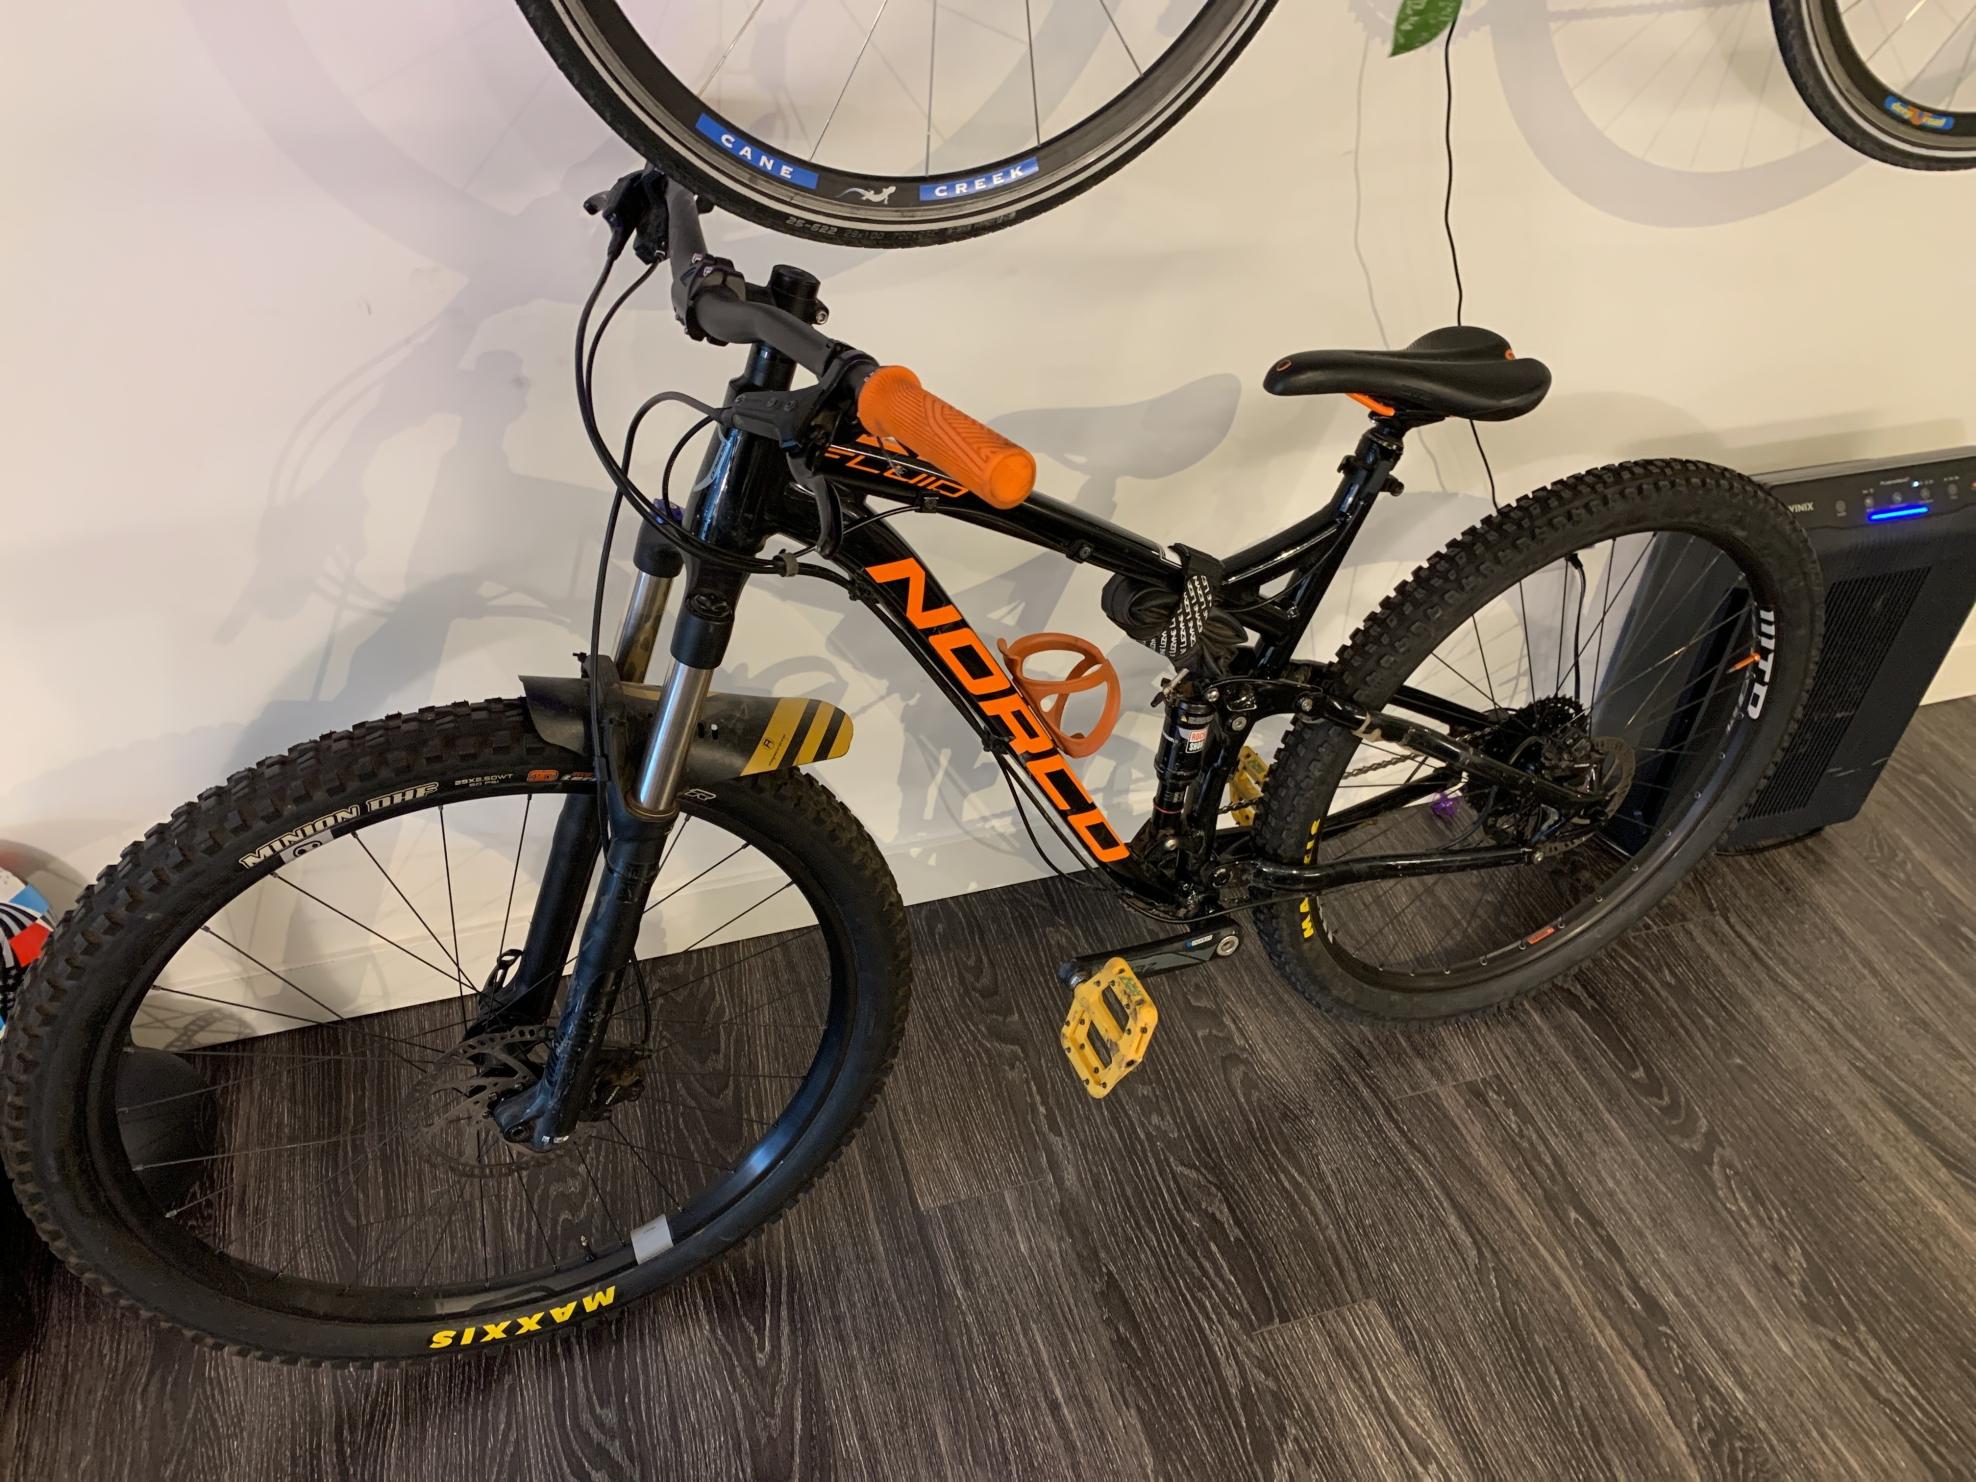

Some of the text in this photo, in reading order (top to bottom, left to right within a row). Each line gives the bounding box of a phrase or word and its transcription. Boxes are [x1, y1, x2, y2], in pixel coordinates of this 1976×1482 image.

[720, 132, 1024, 197] CANE CREEK
[865, 557, 1130, 862] NORCO
[238, 782, 439, 869] MINION DHF
[429, 1285, 616, 1349] MAXXIS
